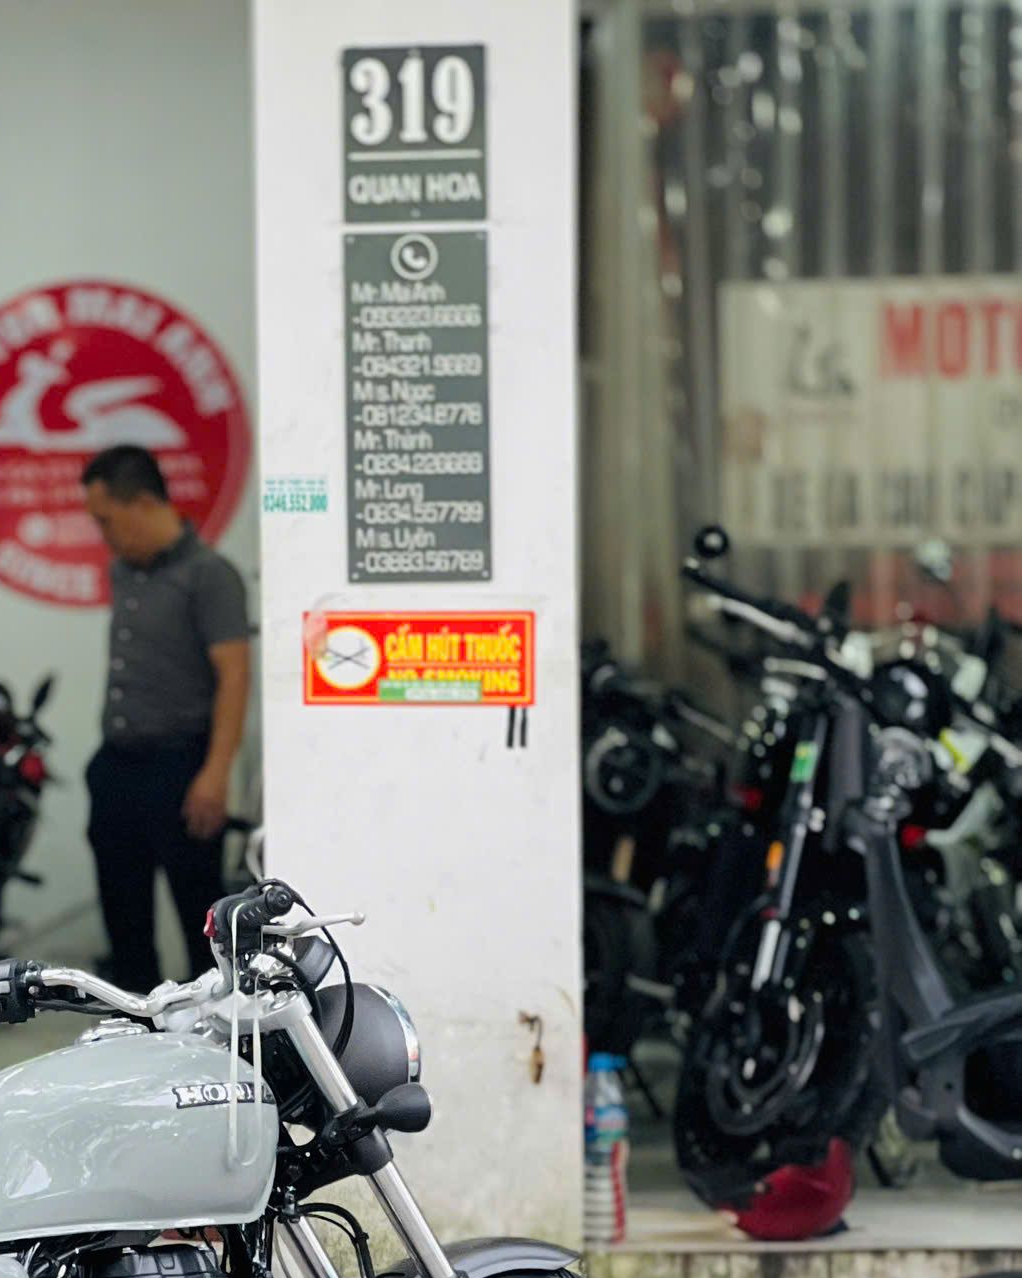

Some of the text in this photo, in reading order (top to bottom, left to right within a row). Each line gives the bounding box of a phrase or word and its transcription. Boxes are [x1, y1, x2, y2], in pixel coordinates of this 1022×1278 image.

[349, 56, 475, 145] 319
[348, 172, 483, 204] QUAN HOA
[880, 300, 1022, 382] MOT
[426, 626, 460, 662] HÚT
[464, 623, 521, 663] THUỐC
